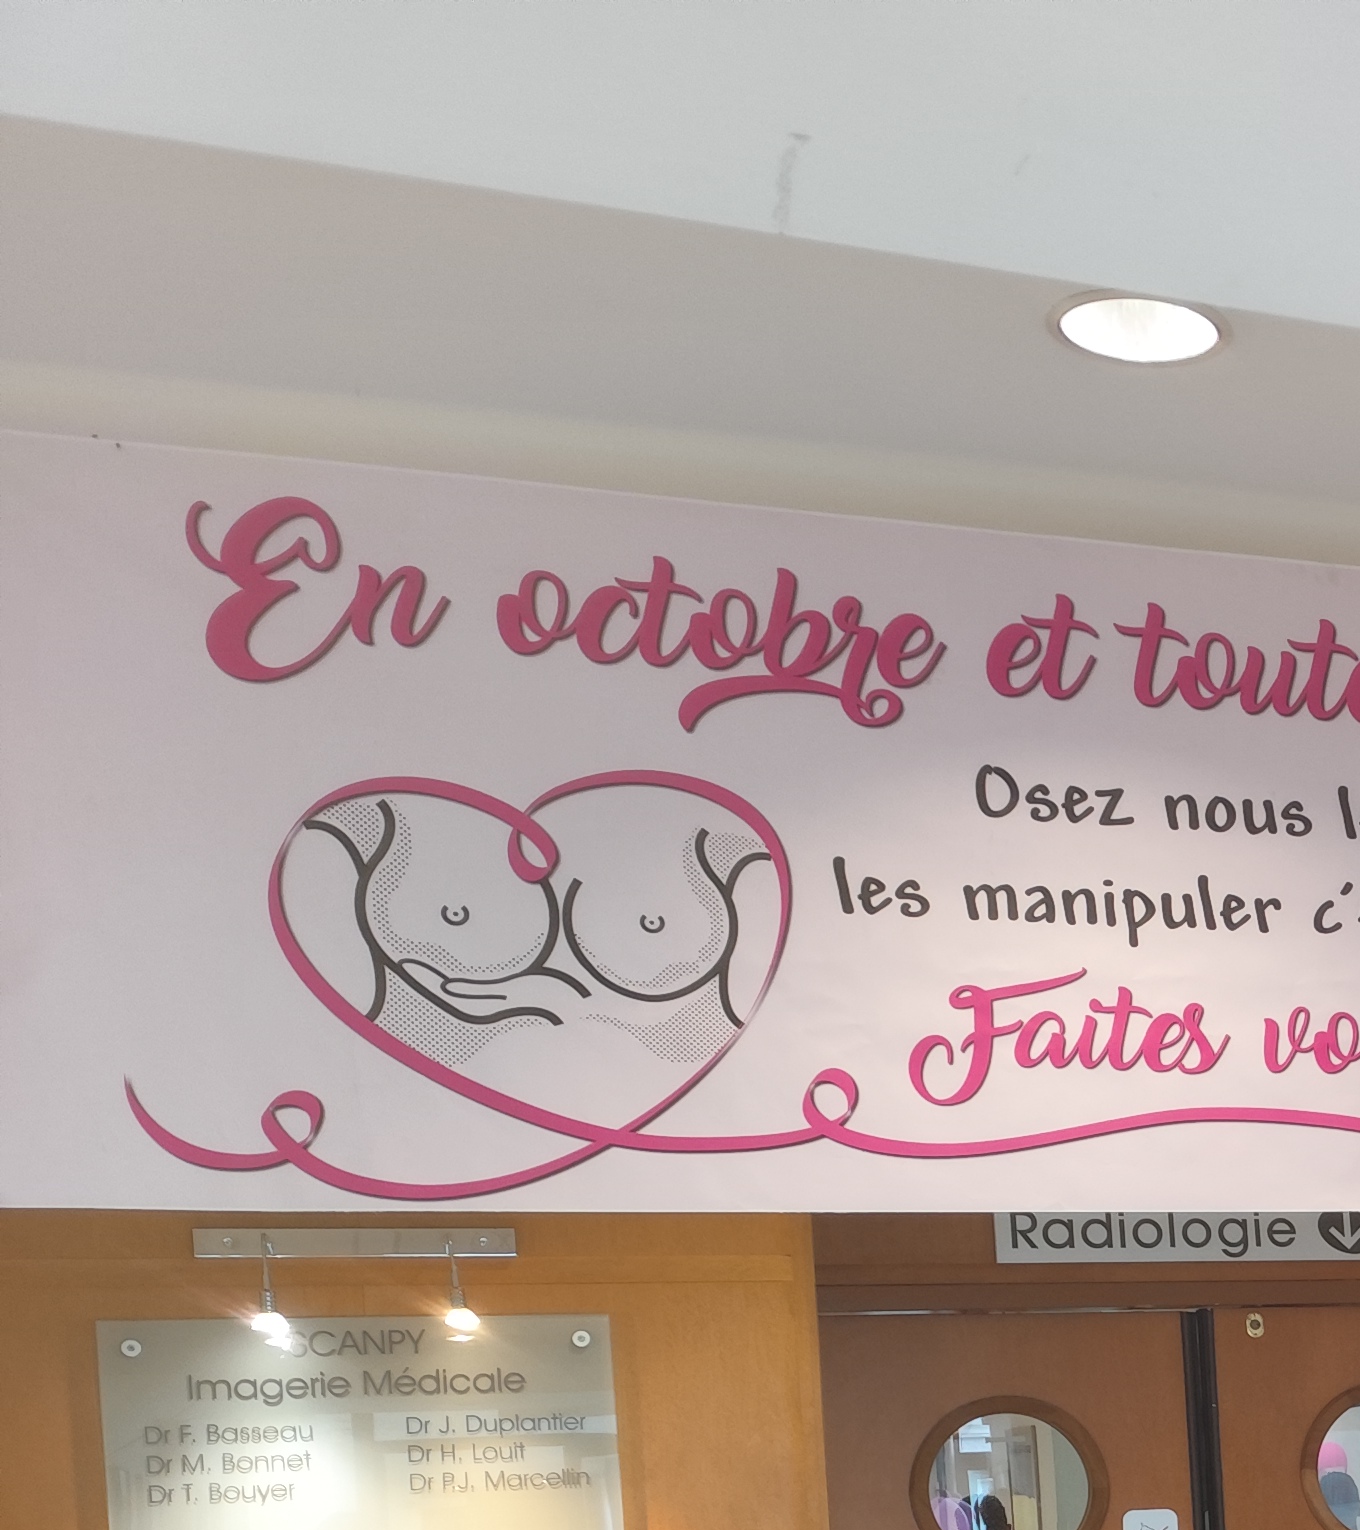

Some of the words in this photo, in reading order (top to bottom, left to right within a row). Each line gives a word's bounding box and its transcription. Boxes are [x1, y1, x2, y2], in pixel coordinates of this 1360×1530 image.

[185, 496, 451, 682] En
[497, 556, 947, 732] octobre
[985, 593, 1099, 701] et
[974, 764, 1135, 827] Osez
[1164, 794, 1313, 838] nous
[831, 857, 931, 919] les
[964, 875, 1281, 948] manipuler
[909, 967, 1230, 1107] Faites
[1010, 1212, 1296, 1258] Radiologie
[286, 1328, 426, 1358] SCANPY
[187, 1371, 351, 1406] Imagerie
[363, 1367, 527, 1397] Médicale
[143, 1425, 170, 1445] Dr
[178, 1424, 196, 1444] F.
[206, 1421, 314, 1444] Basseau
[405, 1416, 431, 1435] Dr
[437, 1416, 456, 1435] J.
[465, 1413, 586, 1438] Duplantier
[145, 1455, 172, 1475] Dr
[181, 1453, 211, 1474] M.
[221, 1449, 311, 1473] Bonnet
[407, 1444, 432, 1464] Dr
[441, 1444, 462, 1463] H.
[473, 1442, 526, 1463] Louit
[147, 1485, 173, 1506] Dr
[180, 1483, 199, 1504] T.
[208, 1481, 295, 1507] Bouyer
[409, 1473, 434, 1493] Dr
[484, 1468, 591, 1492] Marcellin
